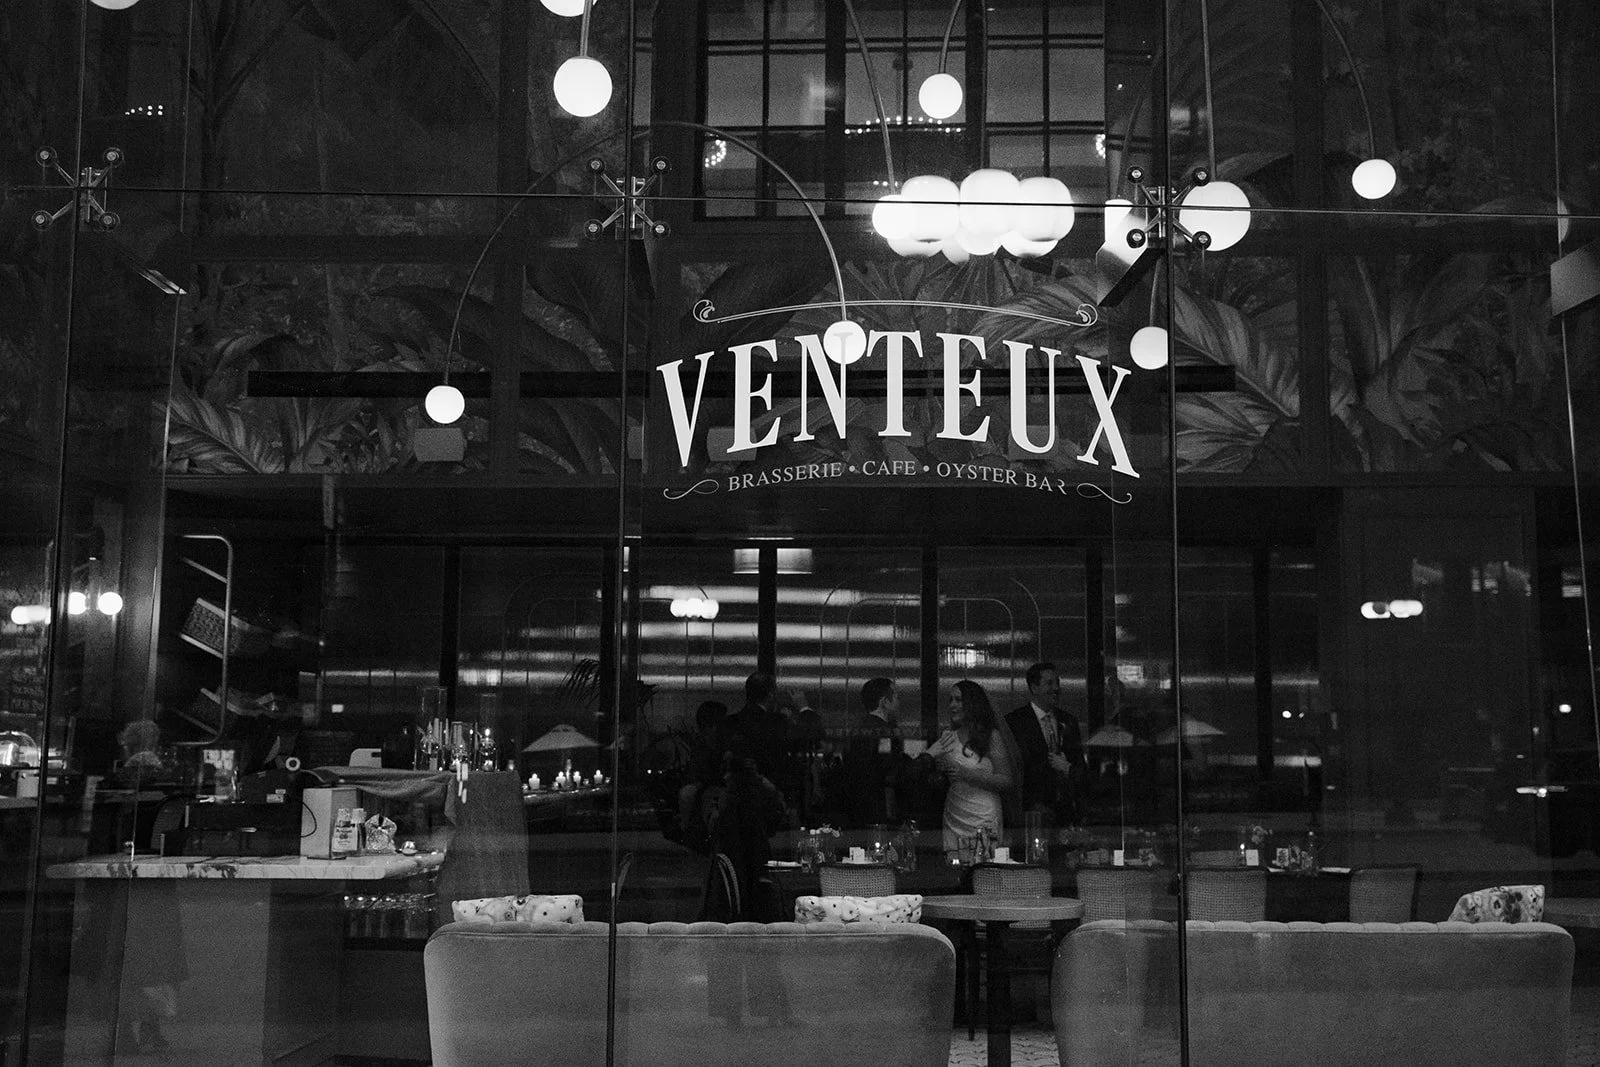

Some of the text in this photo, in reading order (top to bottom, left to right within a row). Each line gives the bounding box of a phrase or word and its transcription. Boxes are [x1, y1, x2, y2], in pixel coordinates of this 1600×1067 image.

[655, 329, 1140, 479] VENTEUX
[728, 460, 1067, 495] BRASSERIE CAFE OYSTER BAR
